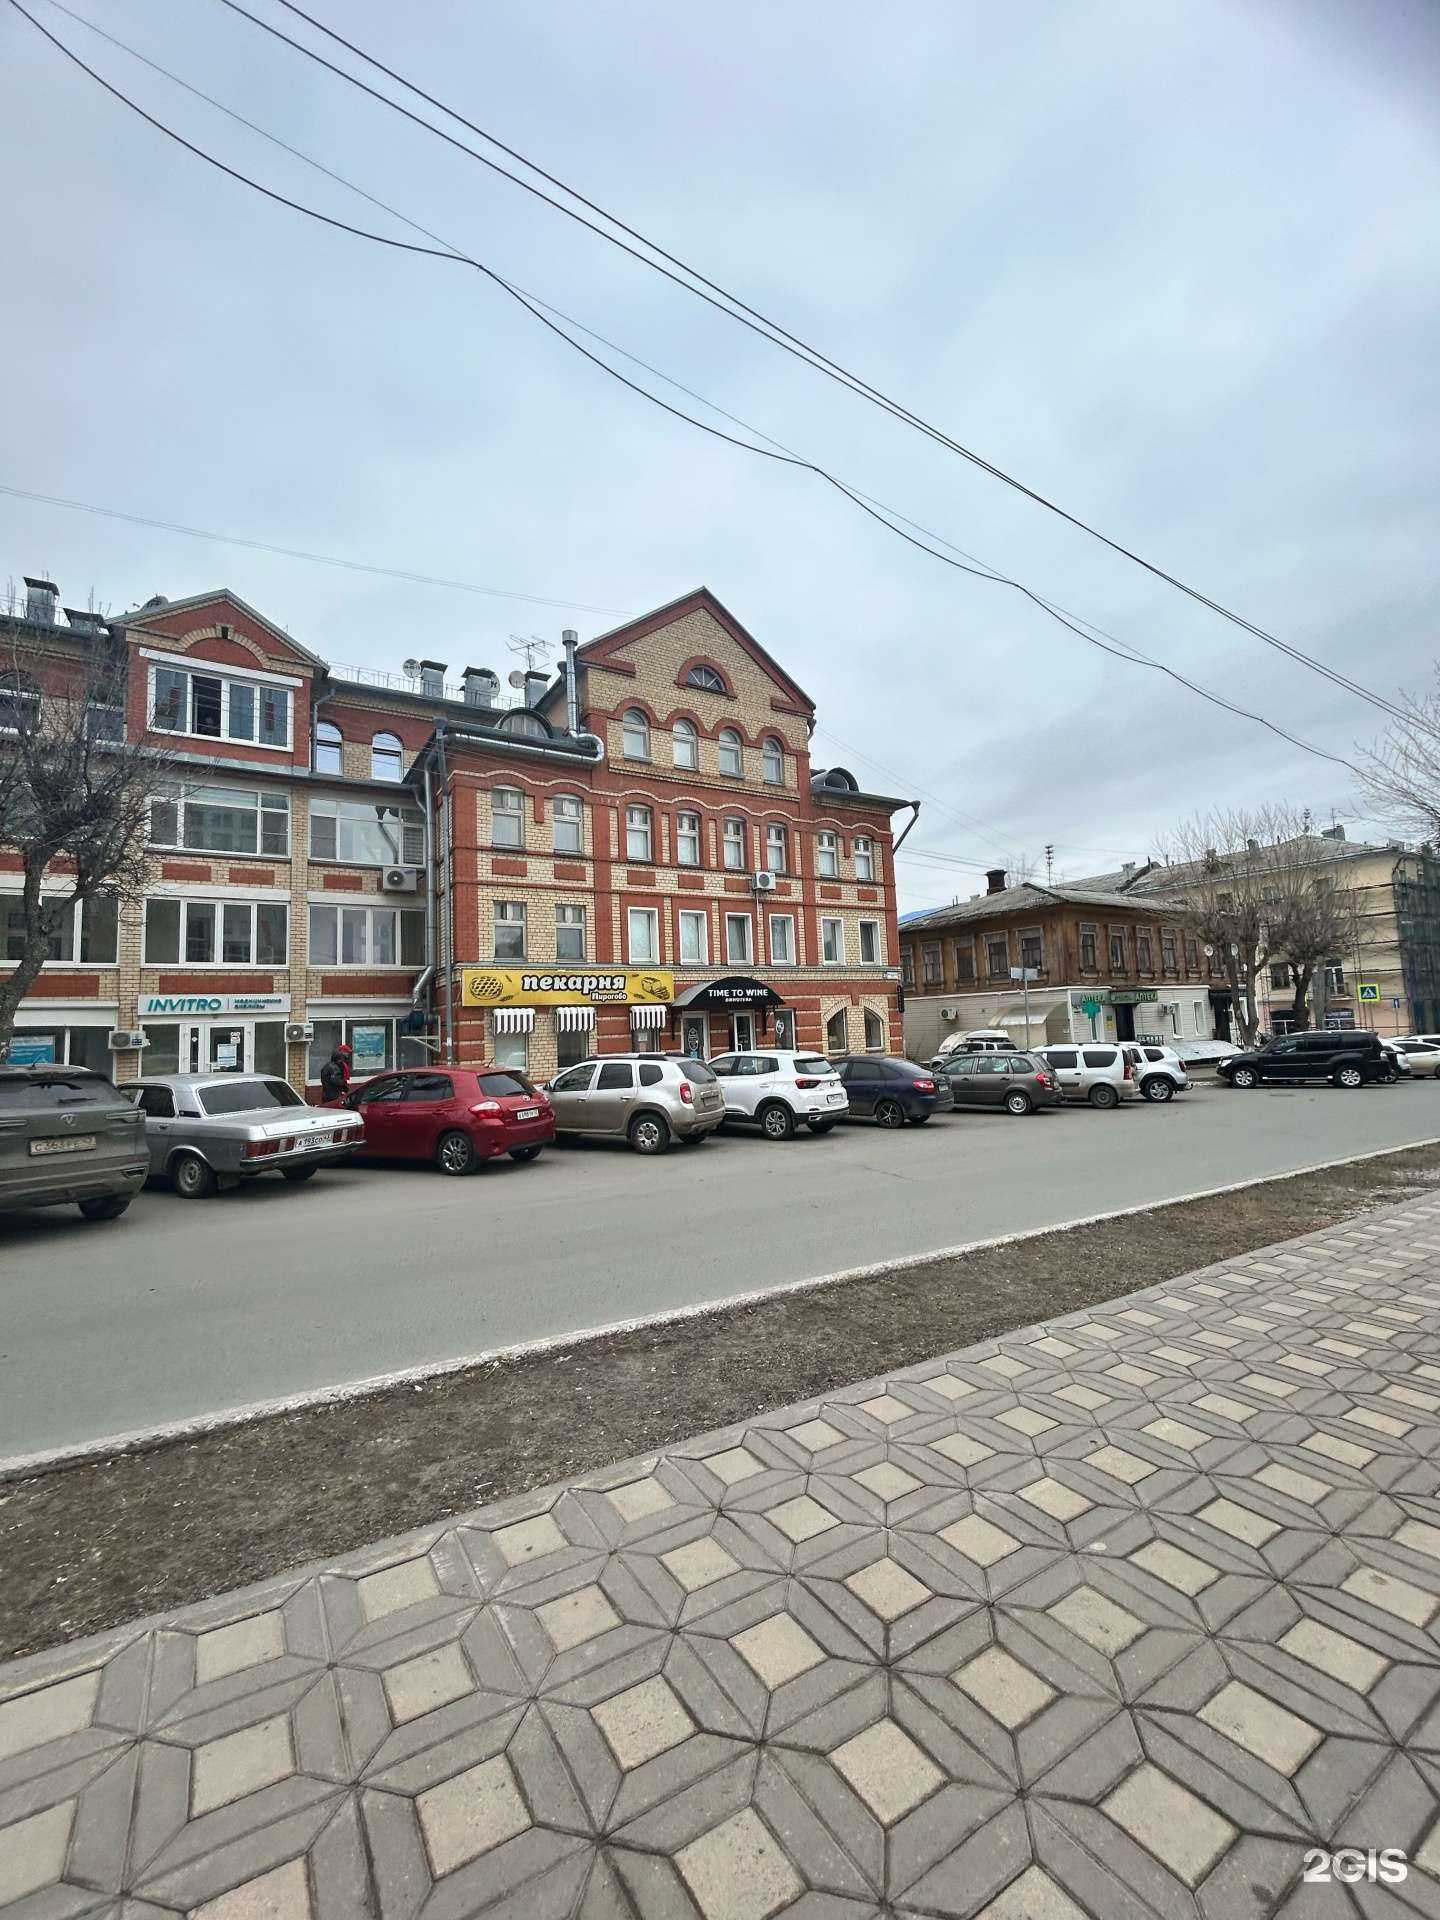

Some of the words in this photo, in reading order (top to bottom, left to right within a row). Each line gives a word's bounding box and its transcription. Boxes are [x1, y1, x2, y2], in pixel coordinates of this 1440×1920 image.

[522, 974, 627, 994] пекарня
[591, 992, 627, 1001] Пирогово
[708, 989, 730, 997] TIME
[731, 989, 744, 997] TO
[745, 988, 769, 997] WINE
[147, 998, 222, 1012] INVITRO
